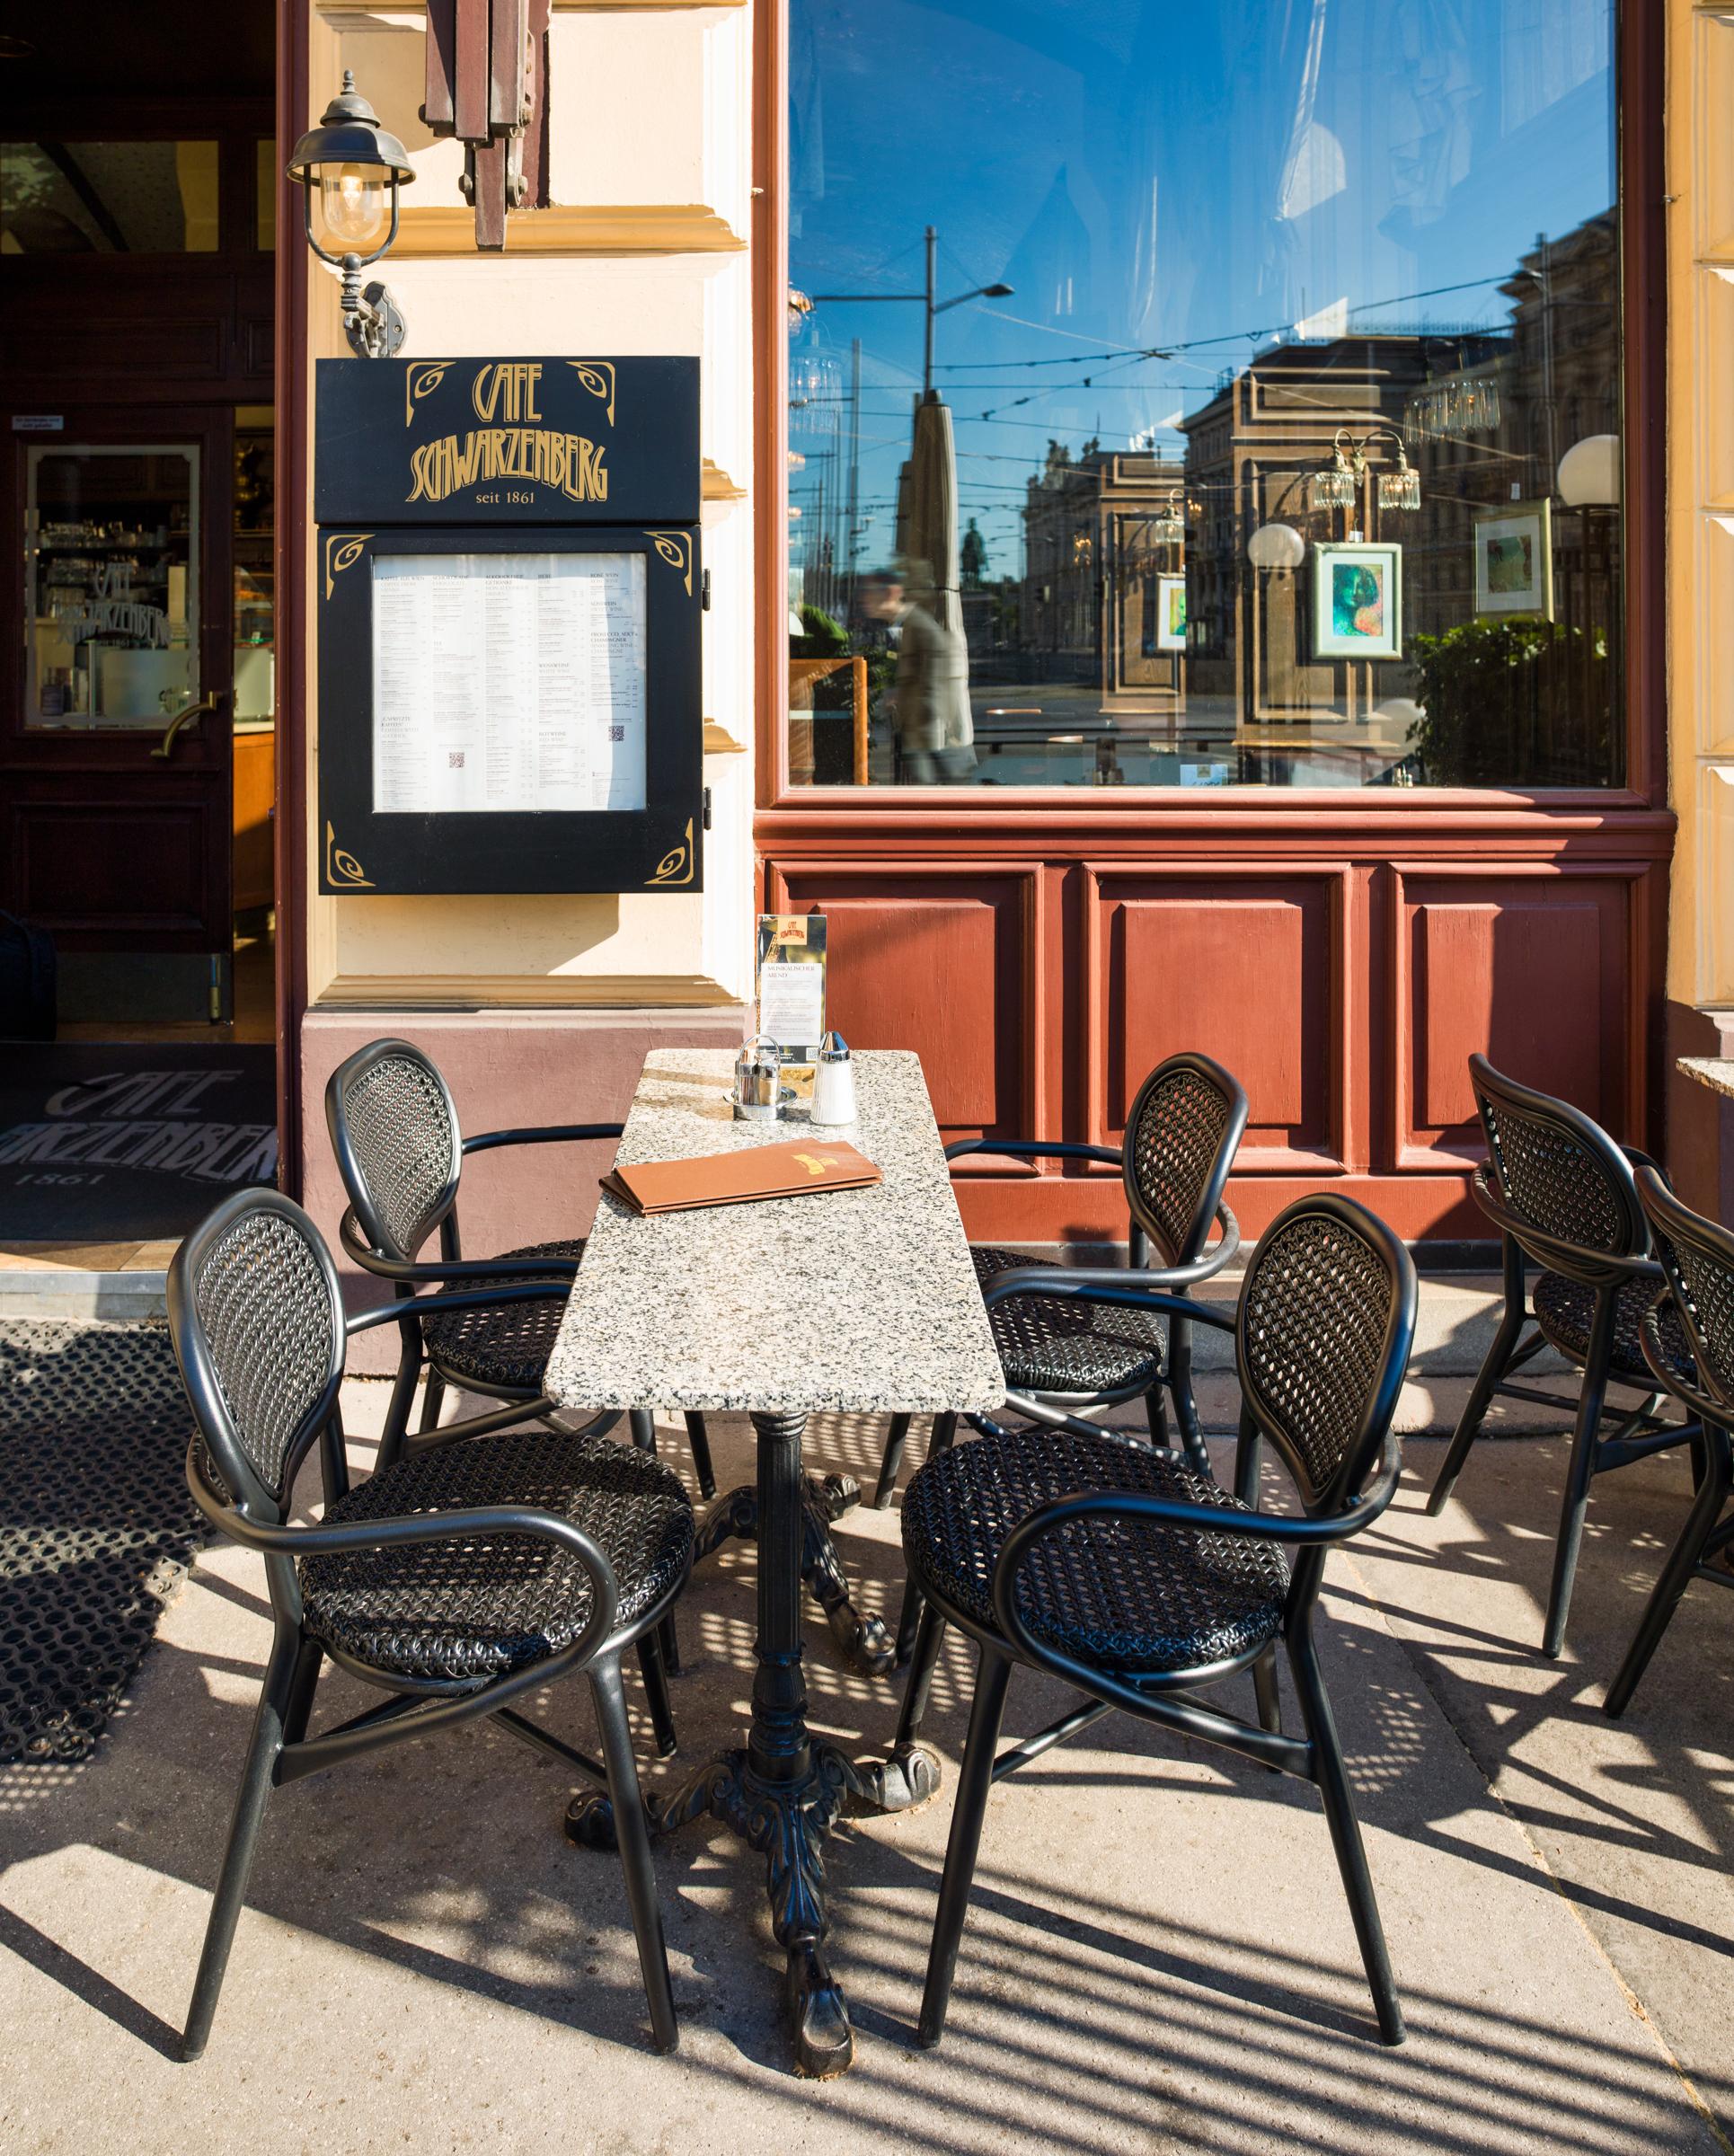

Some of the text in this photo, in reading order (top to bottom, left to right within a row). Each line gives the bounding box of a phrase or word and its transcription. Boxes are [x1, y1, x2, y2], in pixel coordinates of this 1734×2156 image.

[472, 363, 543, 423] CAFE
[405, 428, 608, 502] SCHWARZENBERG
[475, 491, 535, 504] seit 1861
[15, 1173, 106, 1186] 1861
